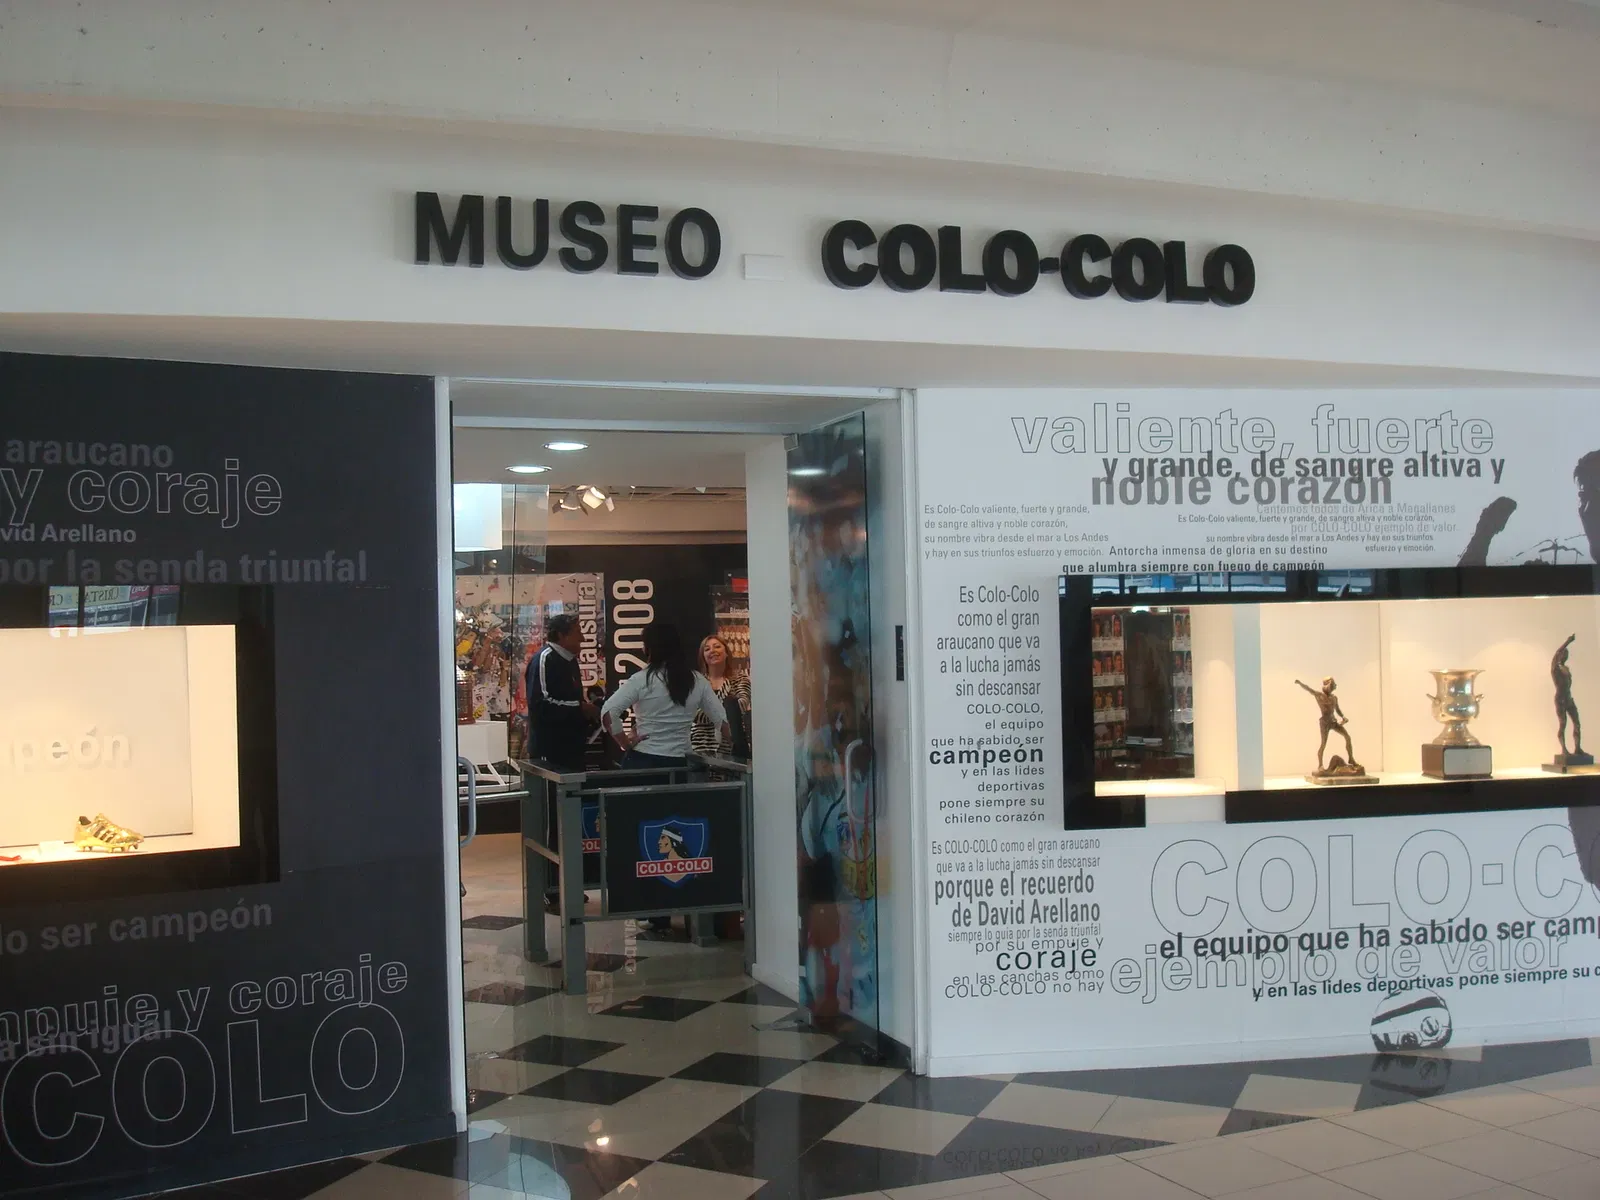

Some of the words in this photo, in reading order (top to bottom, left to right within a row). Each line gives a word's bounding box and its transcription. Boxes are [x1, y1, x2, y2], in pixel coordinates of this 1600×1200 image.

[414, 191, 721, 280] MUSEO
[821, 219, 1256, 308] COLO-COLO
[1011, 402, 1294, 460] valiente,
[1311, 403, 1494, 455] fuerte
[6, 438, 174, 469] araucano
[1102, 457, 1119, 484] y
[1129, 450, 1240, 484] grande,
[1251, 450, 1286, 478] de
[1296, 457, 1394, 484] sangre
[1404, 450, 1482, 478] altiva
[1491, 458, 1505, 484] y
[0, 468, 43, 525] y
[68, 458, 283, 529] coraje
[1092, 466, 1211, 506] noble
[937, 503, 980, 515] Colo-Colo
[981, 503, 1019, 515] valiente,
[1021, 503, 1047, 514] fuerte
[1057, 503, 1090, 515] grande,
[1257, 503, 1309, 514] Cantemos
[1311, 503, 1341, 514] todos
[1358, 503, 1385, 514] Arica
[1397, 502, 1456, 516] Magallanes
[41, 522, 137, 543] Arellano
[938, 520, 969, 532] sangre
[971, 518, 995, 529] altiva
[1004, 518, 1029, 528] noble
[1031, 518, 1068, 529] corazón,
[938, 533, 972, 544] nombre
[973, 533, 994, 543] vibra
[996, 533, 1024, 543] desde
[1038, 534, 1055, 542] mar
[1064, 532, 1080, 542] Los
[1081, 532, 1109, 542] Andes
[932, 547, 949, 559] hay
[963, 548, 979, 557] sus
[981, 546, 1015, 557] triunfos
[1018, 546, 1054, 557] esfuerzo
[1109, 545, 1159, 556] Antorcha
[1161, 545, 1208, 556] inmensa
[1210, 545, 1224, 555] de
[1226, 544, 1257, 558] gloria
[1260, 546, 1272, 555] en
[1275, 546, 1287, 555] su
[1290, 544, 1328, 555] destino
[67, 549, 101, 583] la
[114, 549, 229, 584] senda
[240, 548, 367, 583] triunfal
[1062, 563, 1085, 574] que
[1088, 561, 1137, 573] alumbra
[1141, 561, 1190, 574] siempre
[1194, 562, 1214, 572] con
[1218, 561, 1252, 572] fuego
[1273, 560, 1325, 571] campeón
[960, 585, 974, 603] Es
[978, 584, 1040, 603] Colo-Colo
[612, 579, 654, 674] 2008
[957, 613, 993, 626] como
[997, 609, 1008, 625] el
[1011, 612, 1040, 630] gran
[937, 636, 994, 650] araucano
[998, 637, 1022, 652] que
[1025, 635, 1040, 648] va
[940, 660, 947, 673] a
[951, 656, 961, 672] la
[966, 655, 999, 672] lucha
[1003, 654, 1041, 676] jamás
[956, 679, 974, 696] sin
[978, 678, 1041, 696] descansar
[966, 702, 1044, 714] COLO-COLO,
[985, 719, 996, 730] el
[1000, 719, 1044, 731] equipo
[931, 737, 954, 749] que
[960, 736, 974, 746] ha
[979, 734, 1021, 746] sabido
[1025, 736, 1044, 745] ser
[929, 742, 1043, 768] campeón
[961, 769, 968, 778] y
[973, 767, 988, 777] en
[992, 765, 1010, 776] las
[1014, 765, 1045, 775] lides
[977, 781, 1045, 797] deportivas
[939, 799, 970, 810] pone
[974, 797, 1026, 809] siempre
[1030, 798, 1044, 806] su
[944, 812, 991, 824] chileno
[995, 810, 1045, 822] corazón
[932, 841, 941, 855] Es
[944, 839, 997, 854] COLO-COLO
[1000, 841, 1025, 852] como
[1027, 838, 1035, 852] el
[1038, 840, 1058, 854] gran
[1060, 838, 1101, 851] araucano
[936, 862, 952, 875] que
[987, 858, 1010, 871] lucha
[1012, 856, 1038, 873] jamás
[1041, 856, 1054, 869] sin
[1057, 855, 1101, 869] descansar
[935, 878, 994, 905] porque
[1000, 870, 1014, 896] el
[1021, 868, 1094, 896] recuerdo
[952, 902, 972, 927] de
[978, 899, 1025, 926] David
[1030, 897, 1100, 924] Arellano
[40, 919, 97, 951] ser
[108, 898, 272, 942] campeón
[948, 930, 981, 945] siempre
[1016, 926, 1031, 941] por
[1043, 925, 1068, 938] senda
[1070, 922, 1101, 937] triunfal
[975, 940, 1000, 955] por
[1007, 940, 1025, 950] su
[1031, 937, 1089, 951] empuje
[1160, 933, 1182, 959] el
[1194, 927, 1289, 961] equipo
[1298, 926, 1349, 957] que
[1359, 923, 1390, 948] ha
[1399, 917, 1488, 946] sabido
[1497, 920, 1536, 940] ser
[996, 941, 1097, 974] coraje
[1110, 937, 1336, 1004] ejemplo
[1356, 933, 1421, 980] de
[1438, 930, 1568, 975] valor
[952, 975, 970, 986] en
[976, 972, 996, 985] las
[1001, 969, 1059, 984] canchas
[1065, 969, 1105, 981] como
[1252, 986, 1262, 1001] y
[1267, 984, 1288, 998] en
[1293, 981, 1317, 997] las
[1322, 977, 1362, 996] lides
[1367, 973, 1454, 996] deportivas
[1459, 973, 1499, 990] pone
[1504, 965, 1568, 984] siempre
[1572, 967, 1591, 979] su
[944, 980, 1046, 999] COLO-COLO
[1053, 982, 1072, 994] no
[1078, 979, 1105, 994] hay
[1, 1001, 405, 1168] COLO
